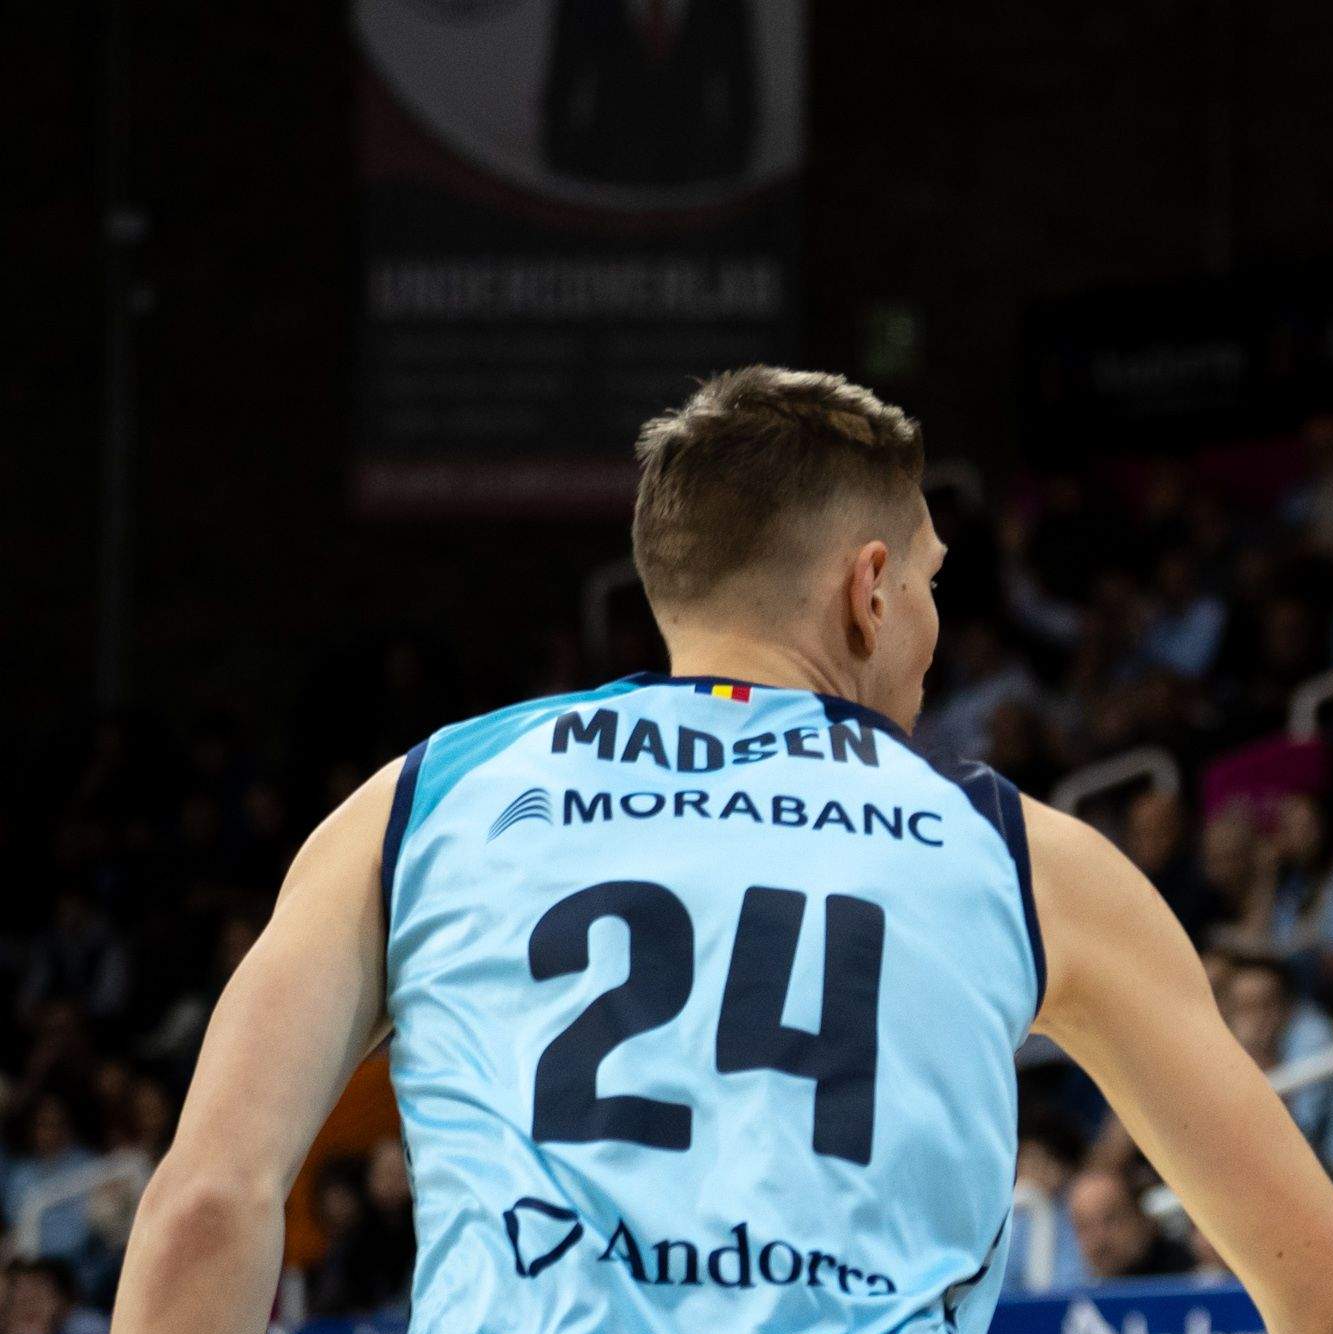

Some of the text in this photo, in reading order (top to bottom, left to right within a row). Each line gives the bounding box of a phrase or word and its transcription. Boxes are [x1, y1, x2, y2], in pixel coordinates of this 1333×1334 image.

[550, 707, 881, 774] MADSEN
[562, 788, 945, 848] MORABANC
[527, 879, 886, 1168] 24
[595, 1222, 899, 1297] Andorra
